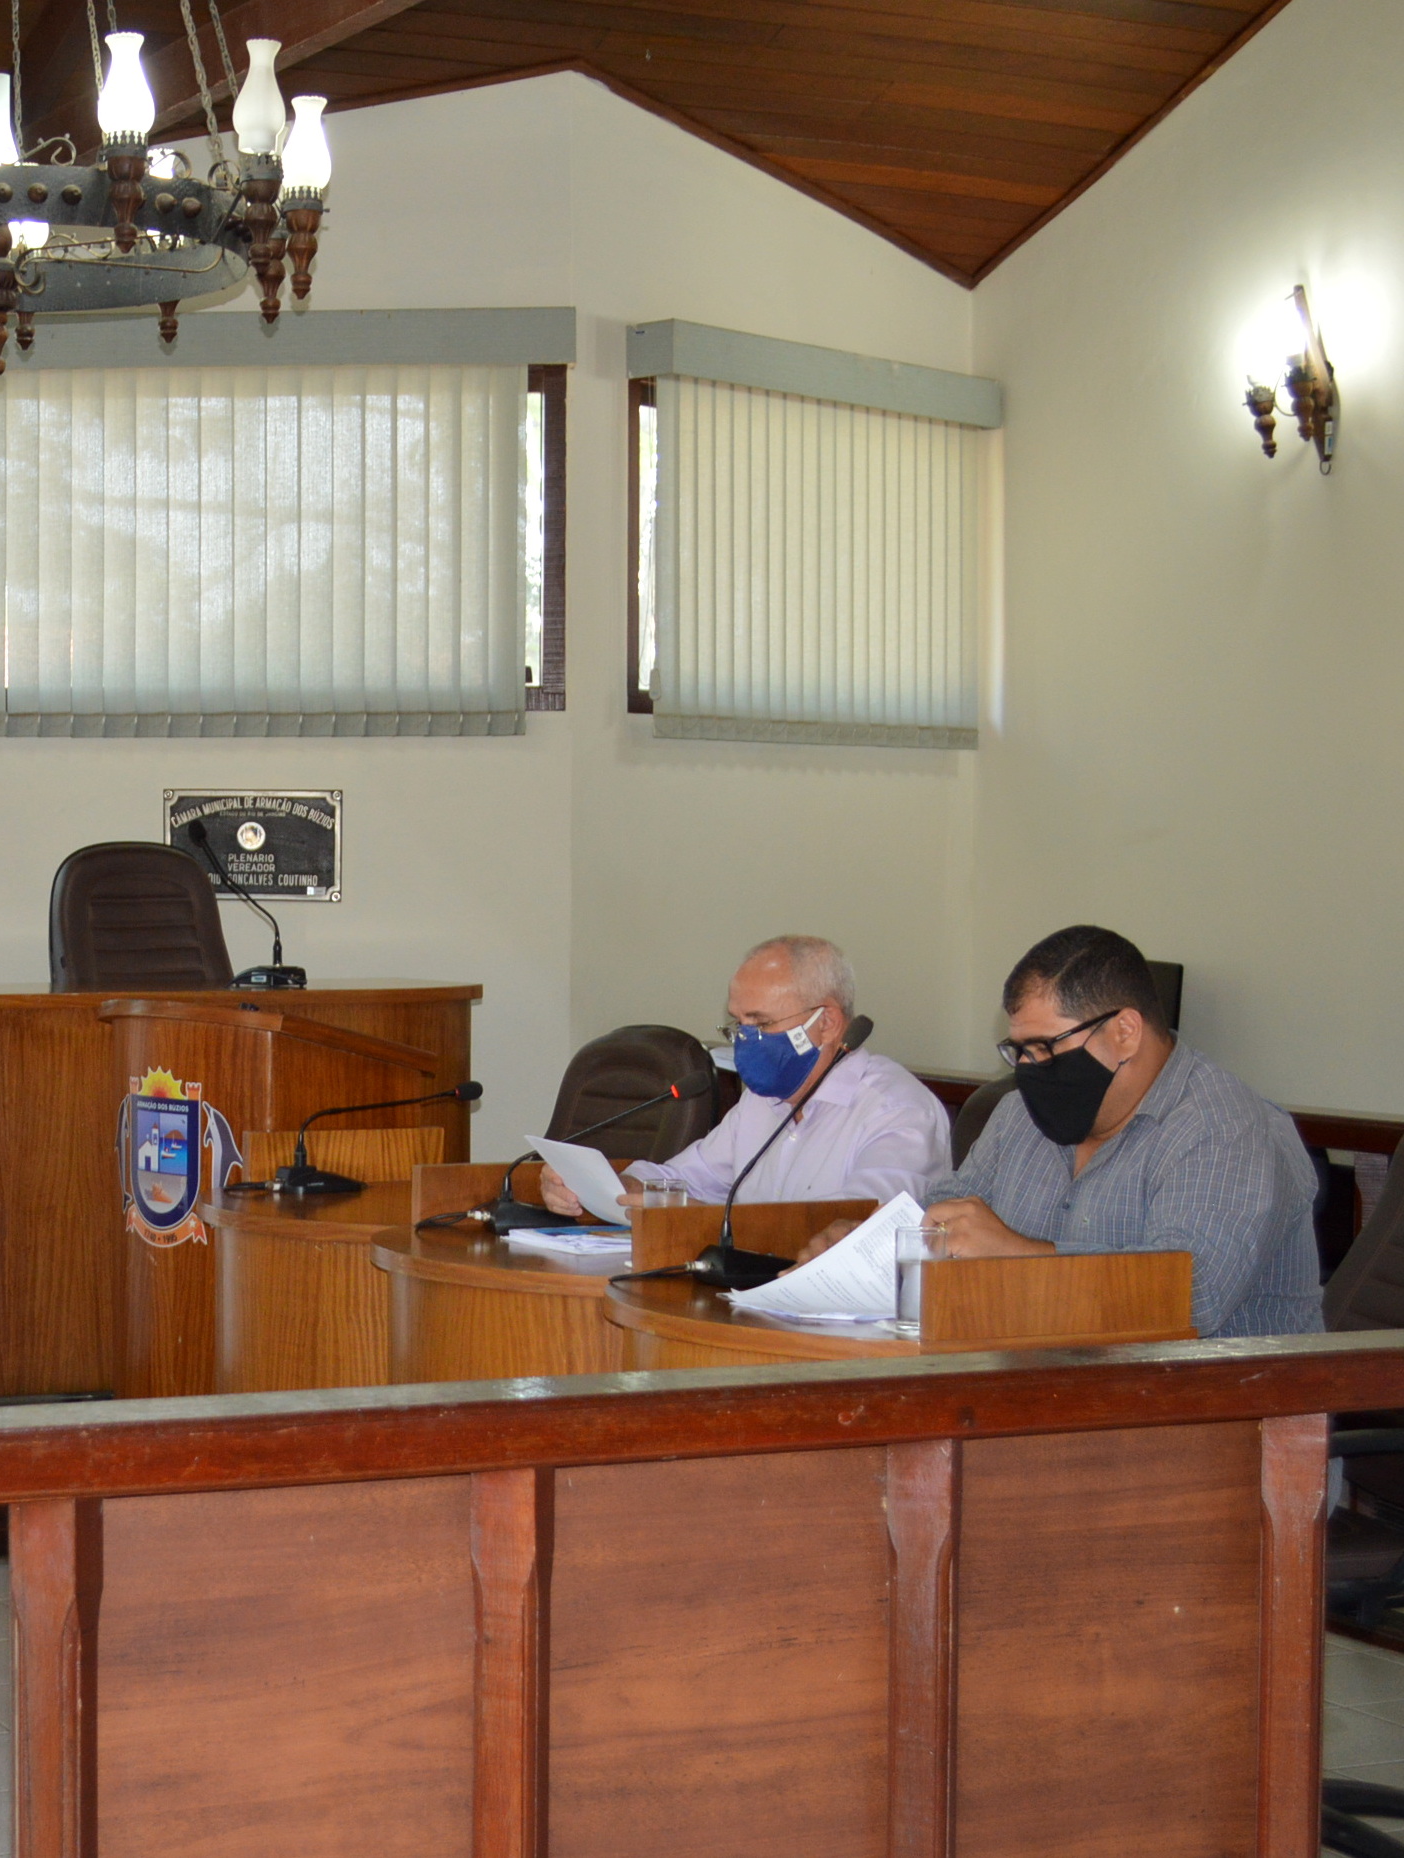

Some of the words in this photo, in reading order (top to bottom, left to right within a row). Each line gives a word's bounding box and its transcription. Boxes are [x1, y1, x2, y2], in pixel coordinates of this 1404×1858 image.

[170, 806, 203, 828] CÂMARA
[202, 797, 243, 816] MUNICIPAL
[244, 796, 254, 809] DE
[255, 796, 292, 813] ARMAÇÃO
[292, 802, 308, 818] DOS
[307, 808, 335, 830] BÚZIOS
[227, 852, 275, 863] PLENÁRIO
[227, 863, 276, 873] VEREADOR
[278, 873, 319, 887] COUTINHO
